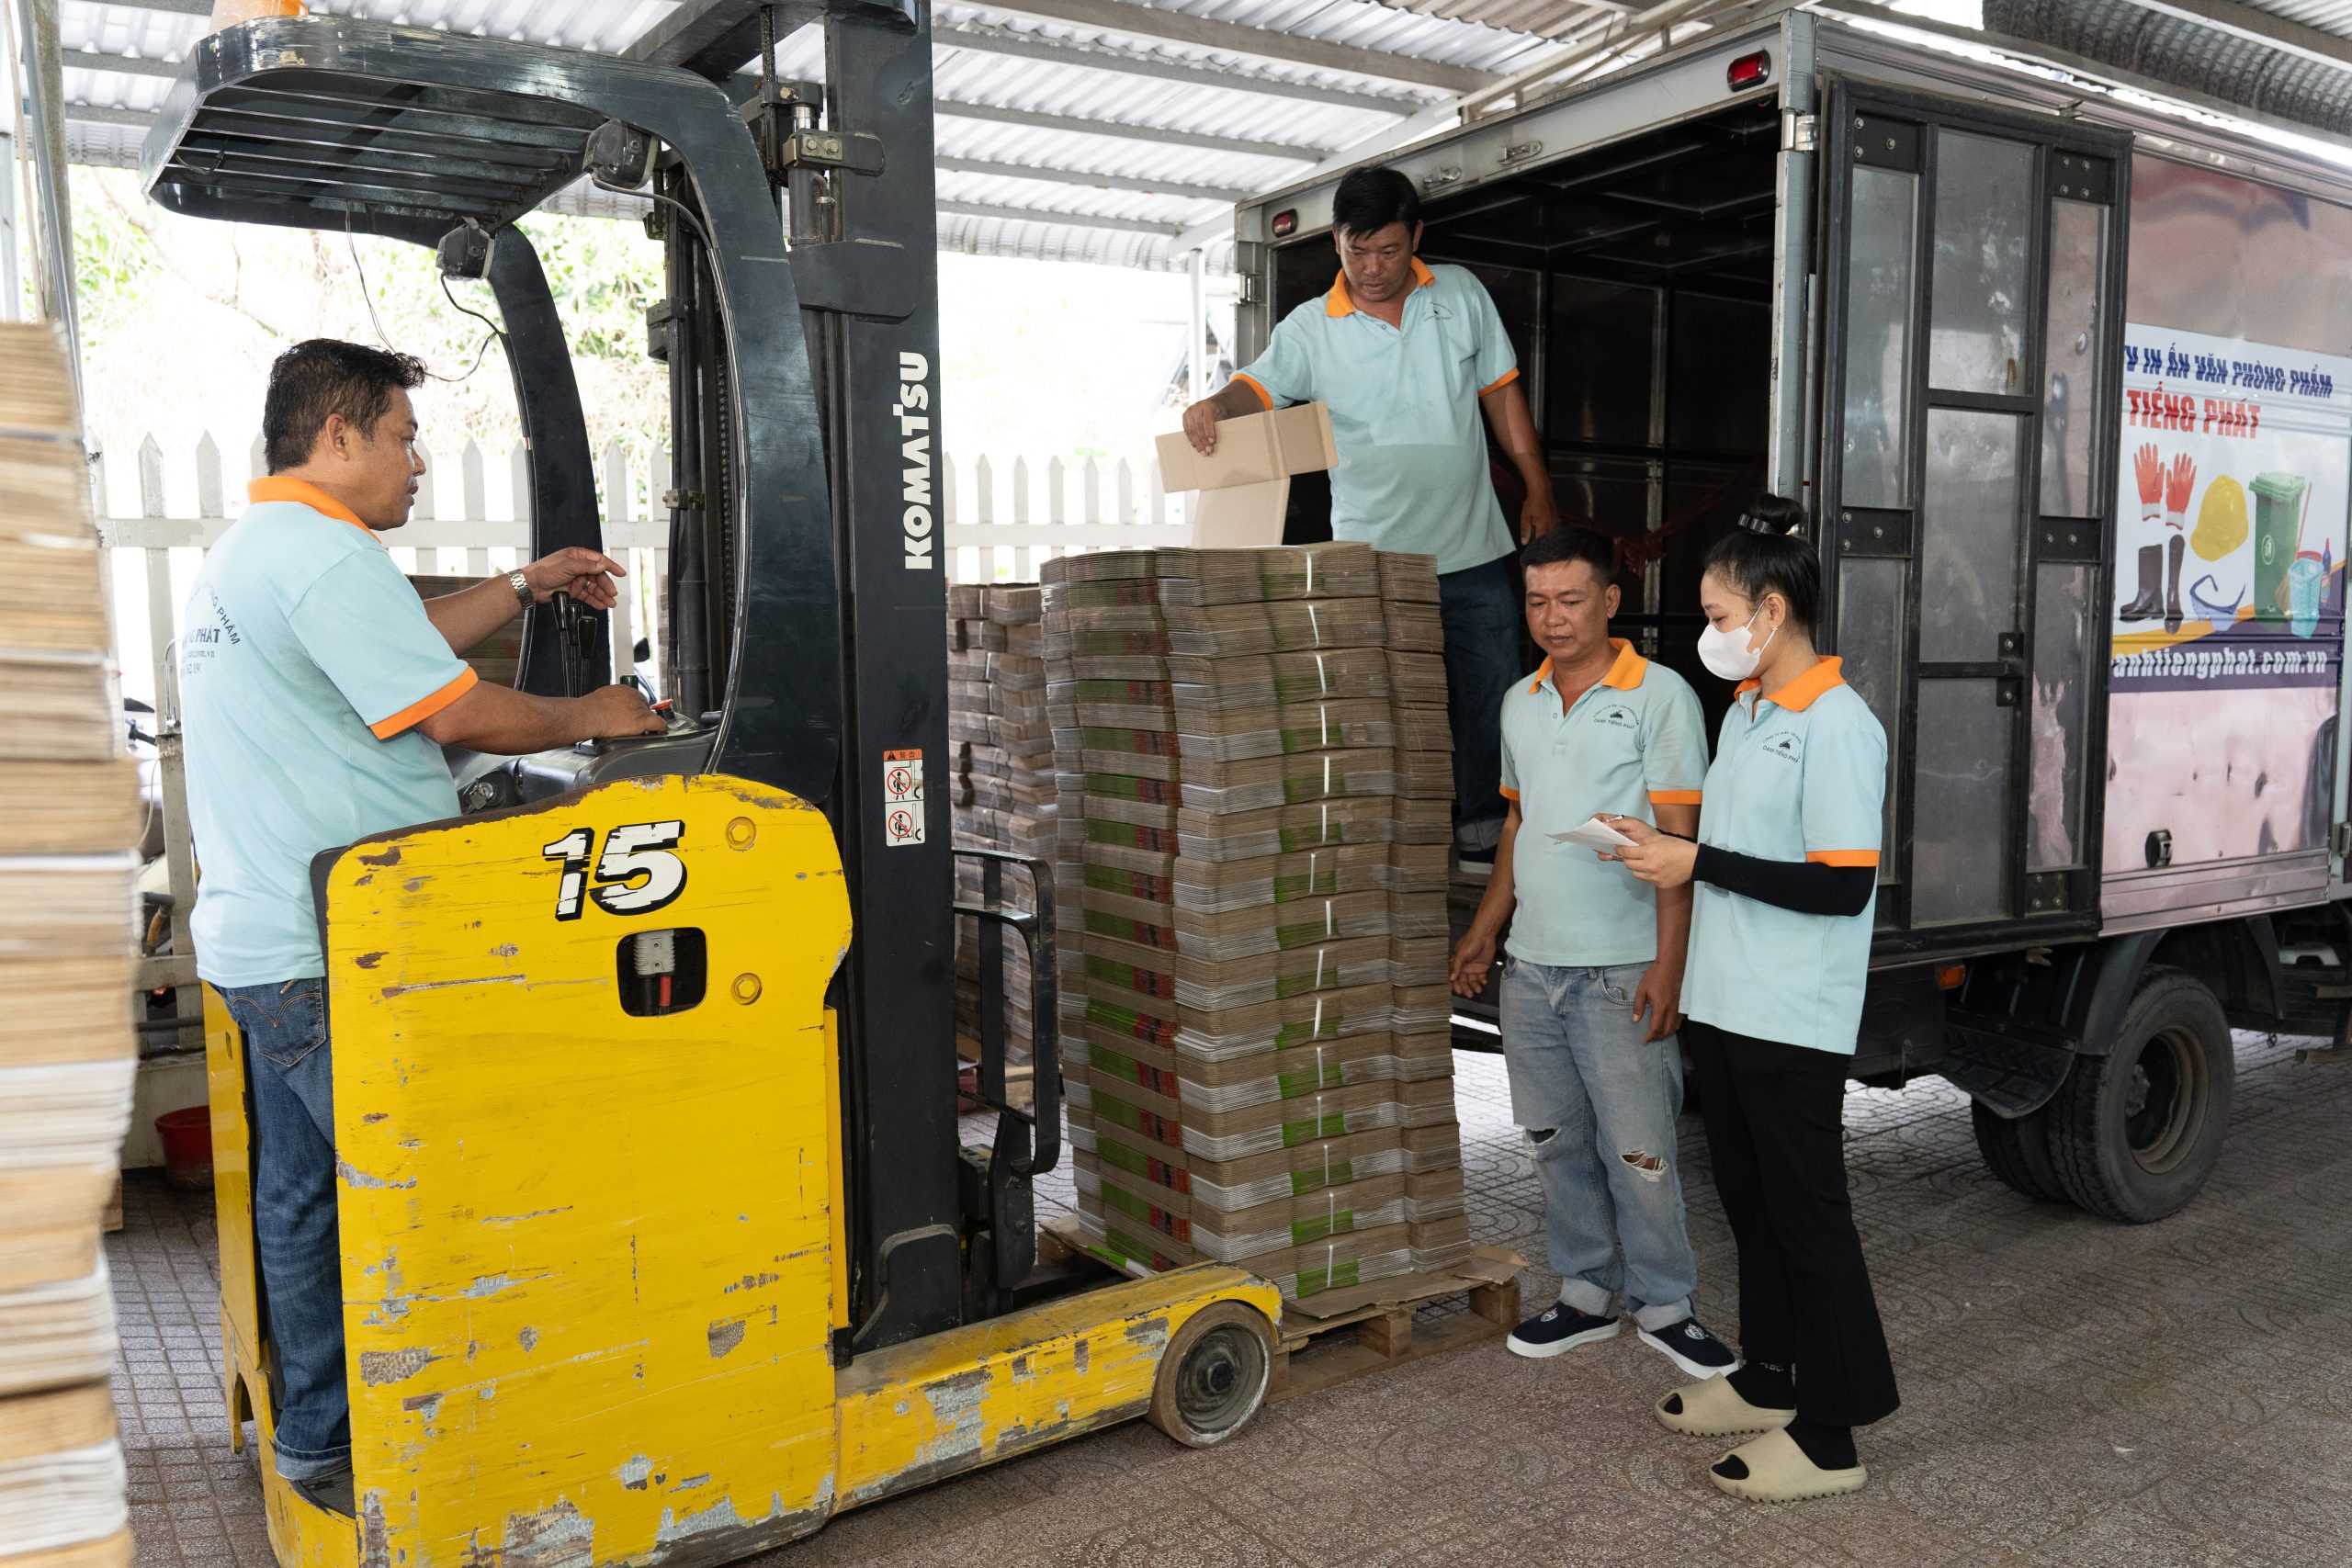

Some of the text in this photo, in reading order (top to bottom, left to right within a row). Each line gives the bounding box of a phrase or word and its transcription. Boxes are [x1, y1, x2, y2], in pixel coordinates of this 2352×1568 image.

[2143, 348, 2162, 375] IN
[2165, 343, 2190, 378] ẤN
[2195, 352, 2228, 384] VĂN
[2232, 360, 2286, 392] PHÒNG
[2289, 364, 2333, 399] PHẨM
[2127, 380, 2260, 439] TIẾNG PHÁT
[892, 351, 933, 570] KOMATSU
[2111, 647, 2328, 679] anhtiengphat.com.vn
[542, 819, 688, 921] 15
